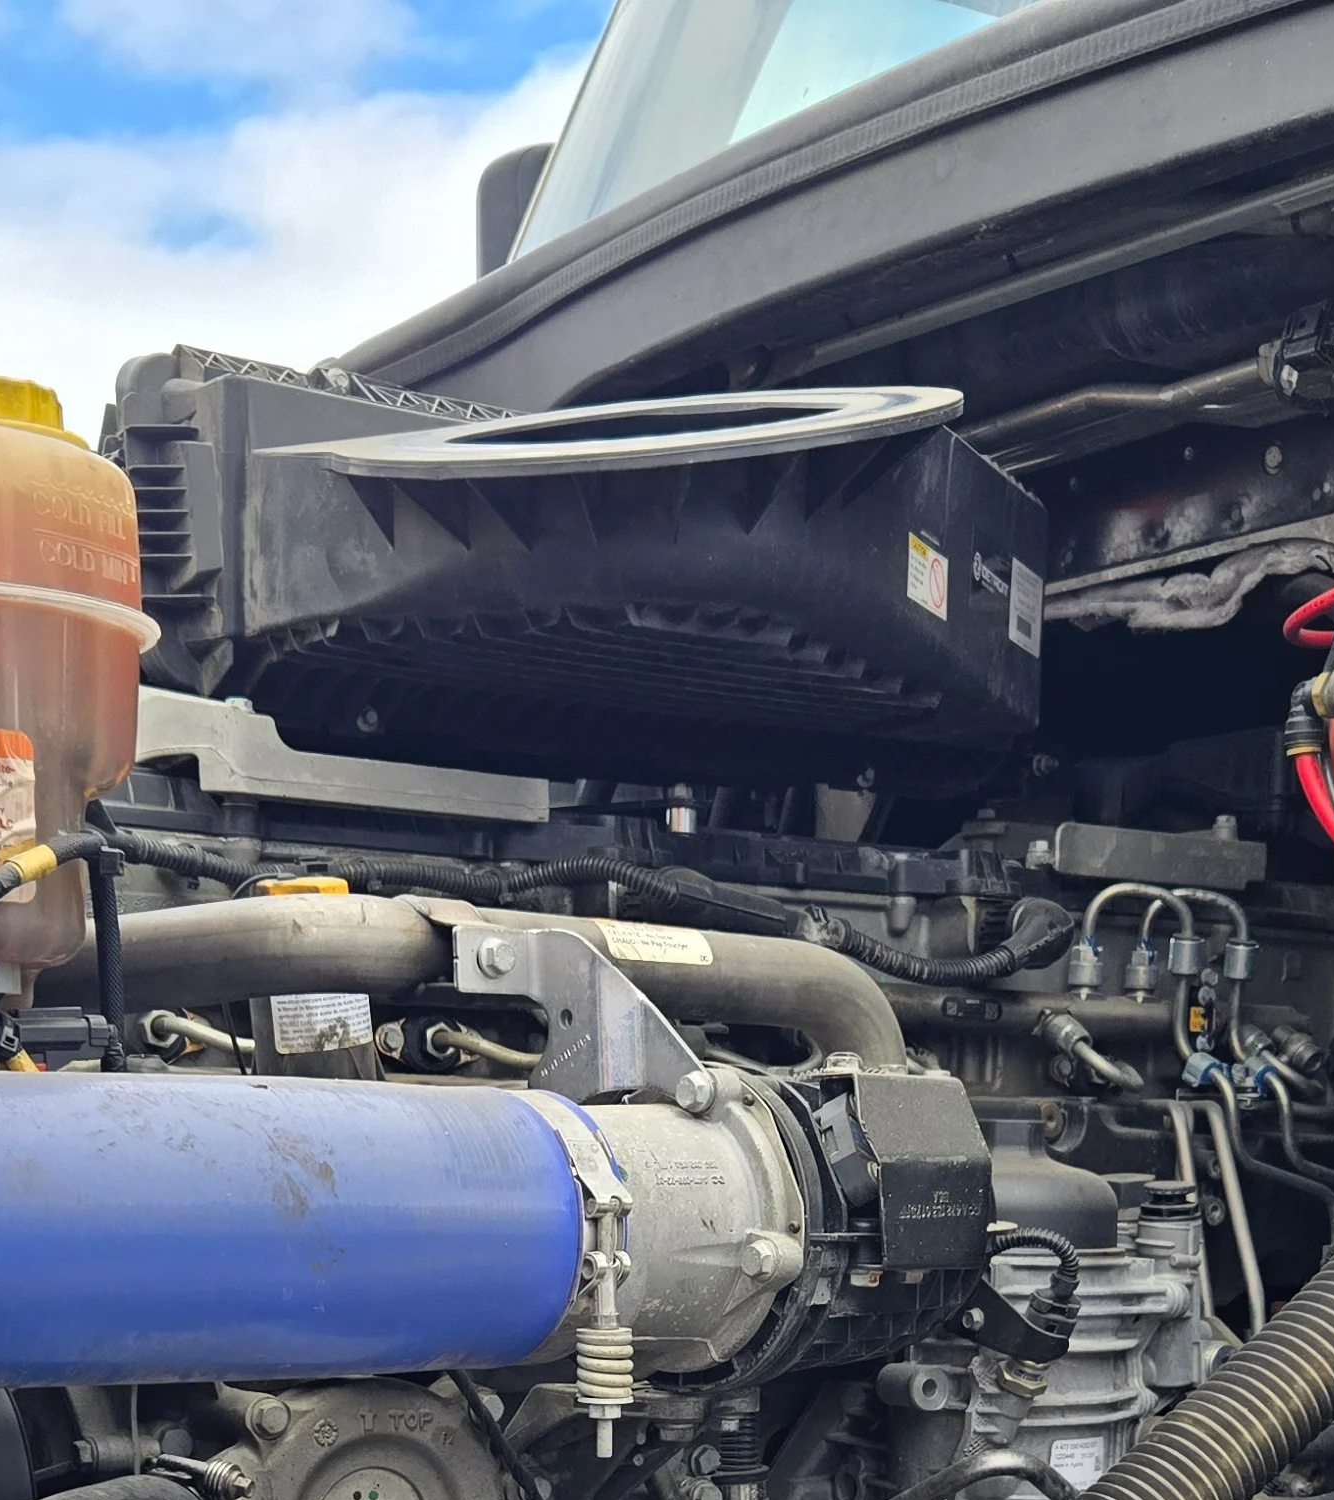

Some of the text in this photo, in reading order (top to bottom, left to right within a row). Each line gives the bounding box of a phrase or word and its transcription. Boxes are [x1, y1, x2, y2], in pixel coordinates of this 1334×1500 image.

[32, 491, 92, 526] COLD
[39, 539, 95, 572] COLD
[982, 564, 1009, 596] DETROIT
[388, 1408, 434, 1432] TOP
